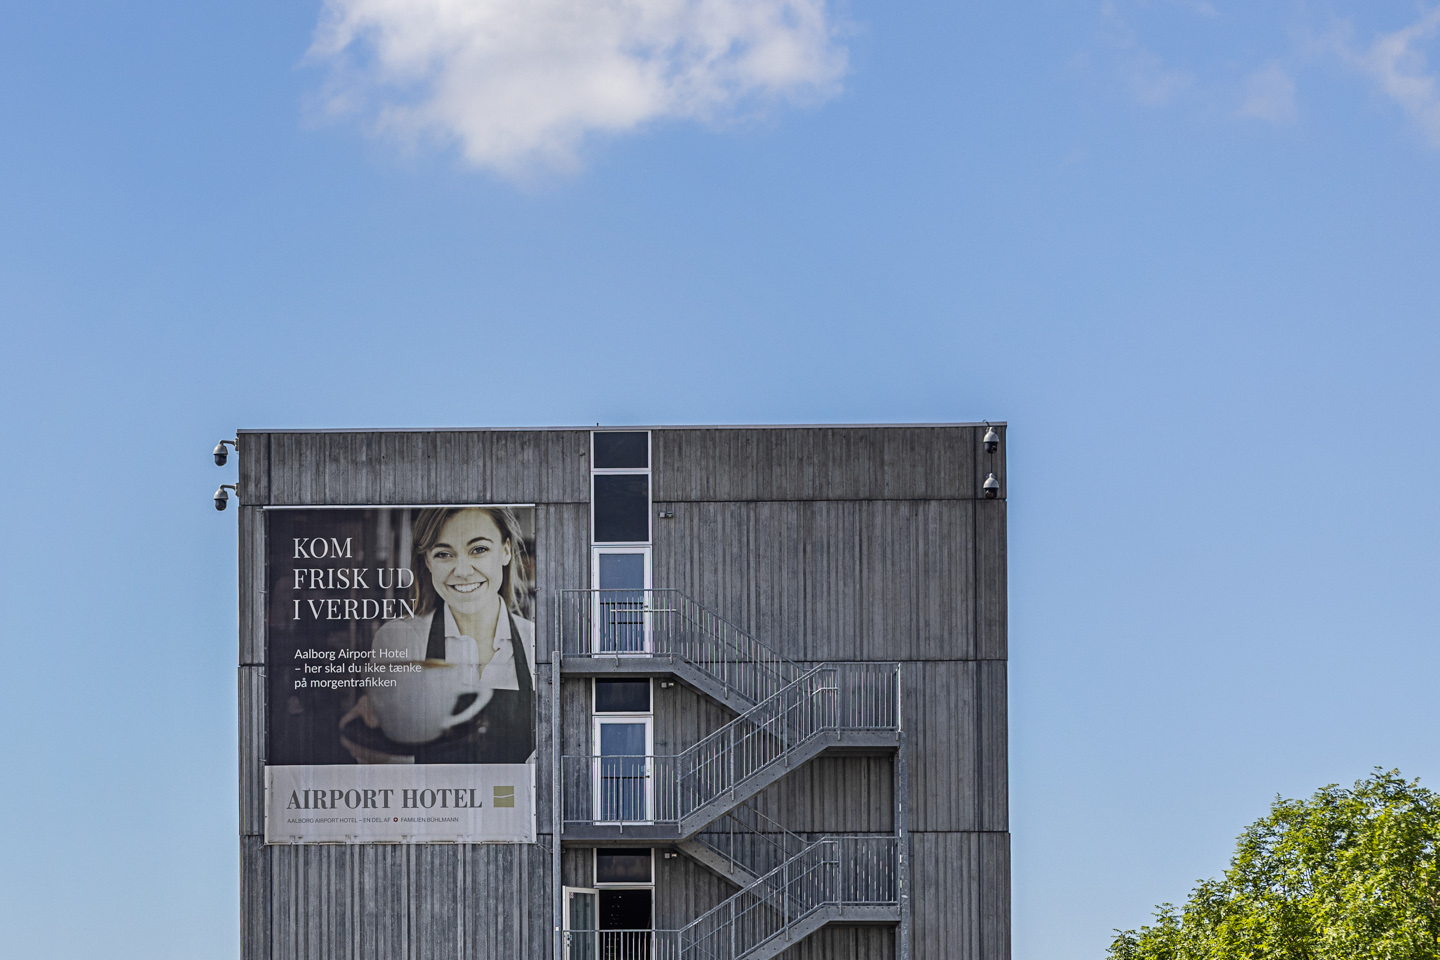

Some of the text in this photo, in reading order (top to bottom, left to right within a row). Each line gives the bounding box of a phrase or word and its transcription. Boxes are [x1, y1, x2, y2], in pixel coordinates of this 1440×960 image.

[293, 537, 353, 559] KOM
[293, 567, 415, 590] FRISK UD
[293, 598, 417, 620] I VERDEN
[294, 648, 409, 660] Aalborg Airport Hotel
[304, 663, 323, 673] her
[324, 663, 345, 673] skal
[348, 663, 361, 673] du
[364, 662, 386, 673] ikke
[389, 663, 422, 673] tænke
[294, 677, 397, 689] på morgentrafikken
[286, 787, 483, 810] AIRPORT HOTEL
